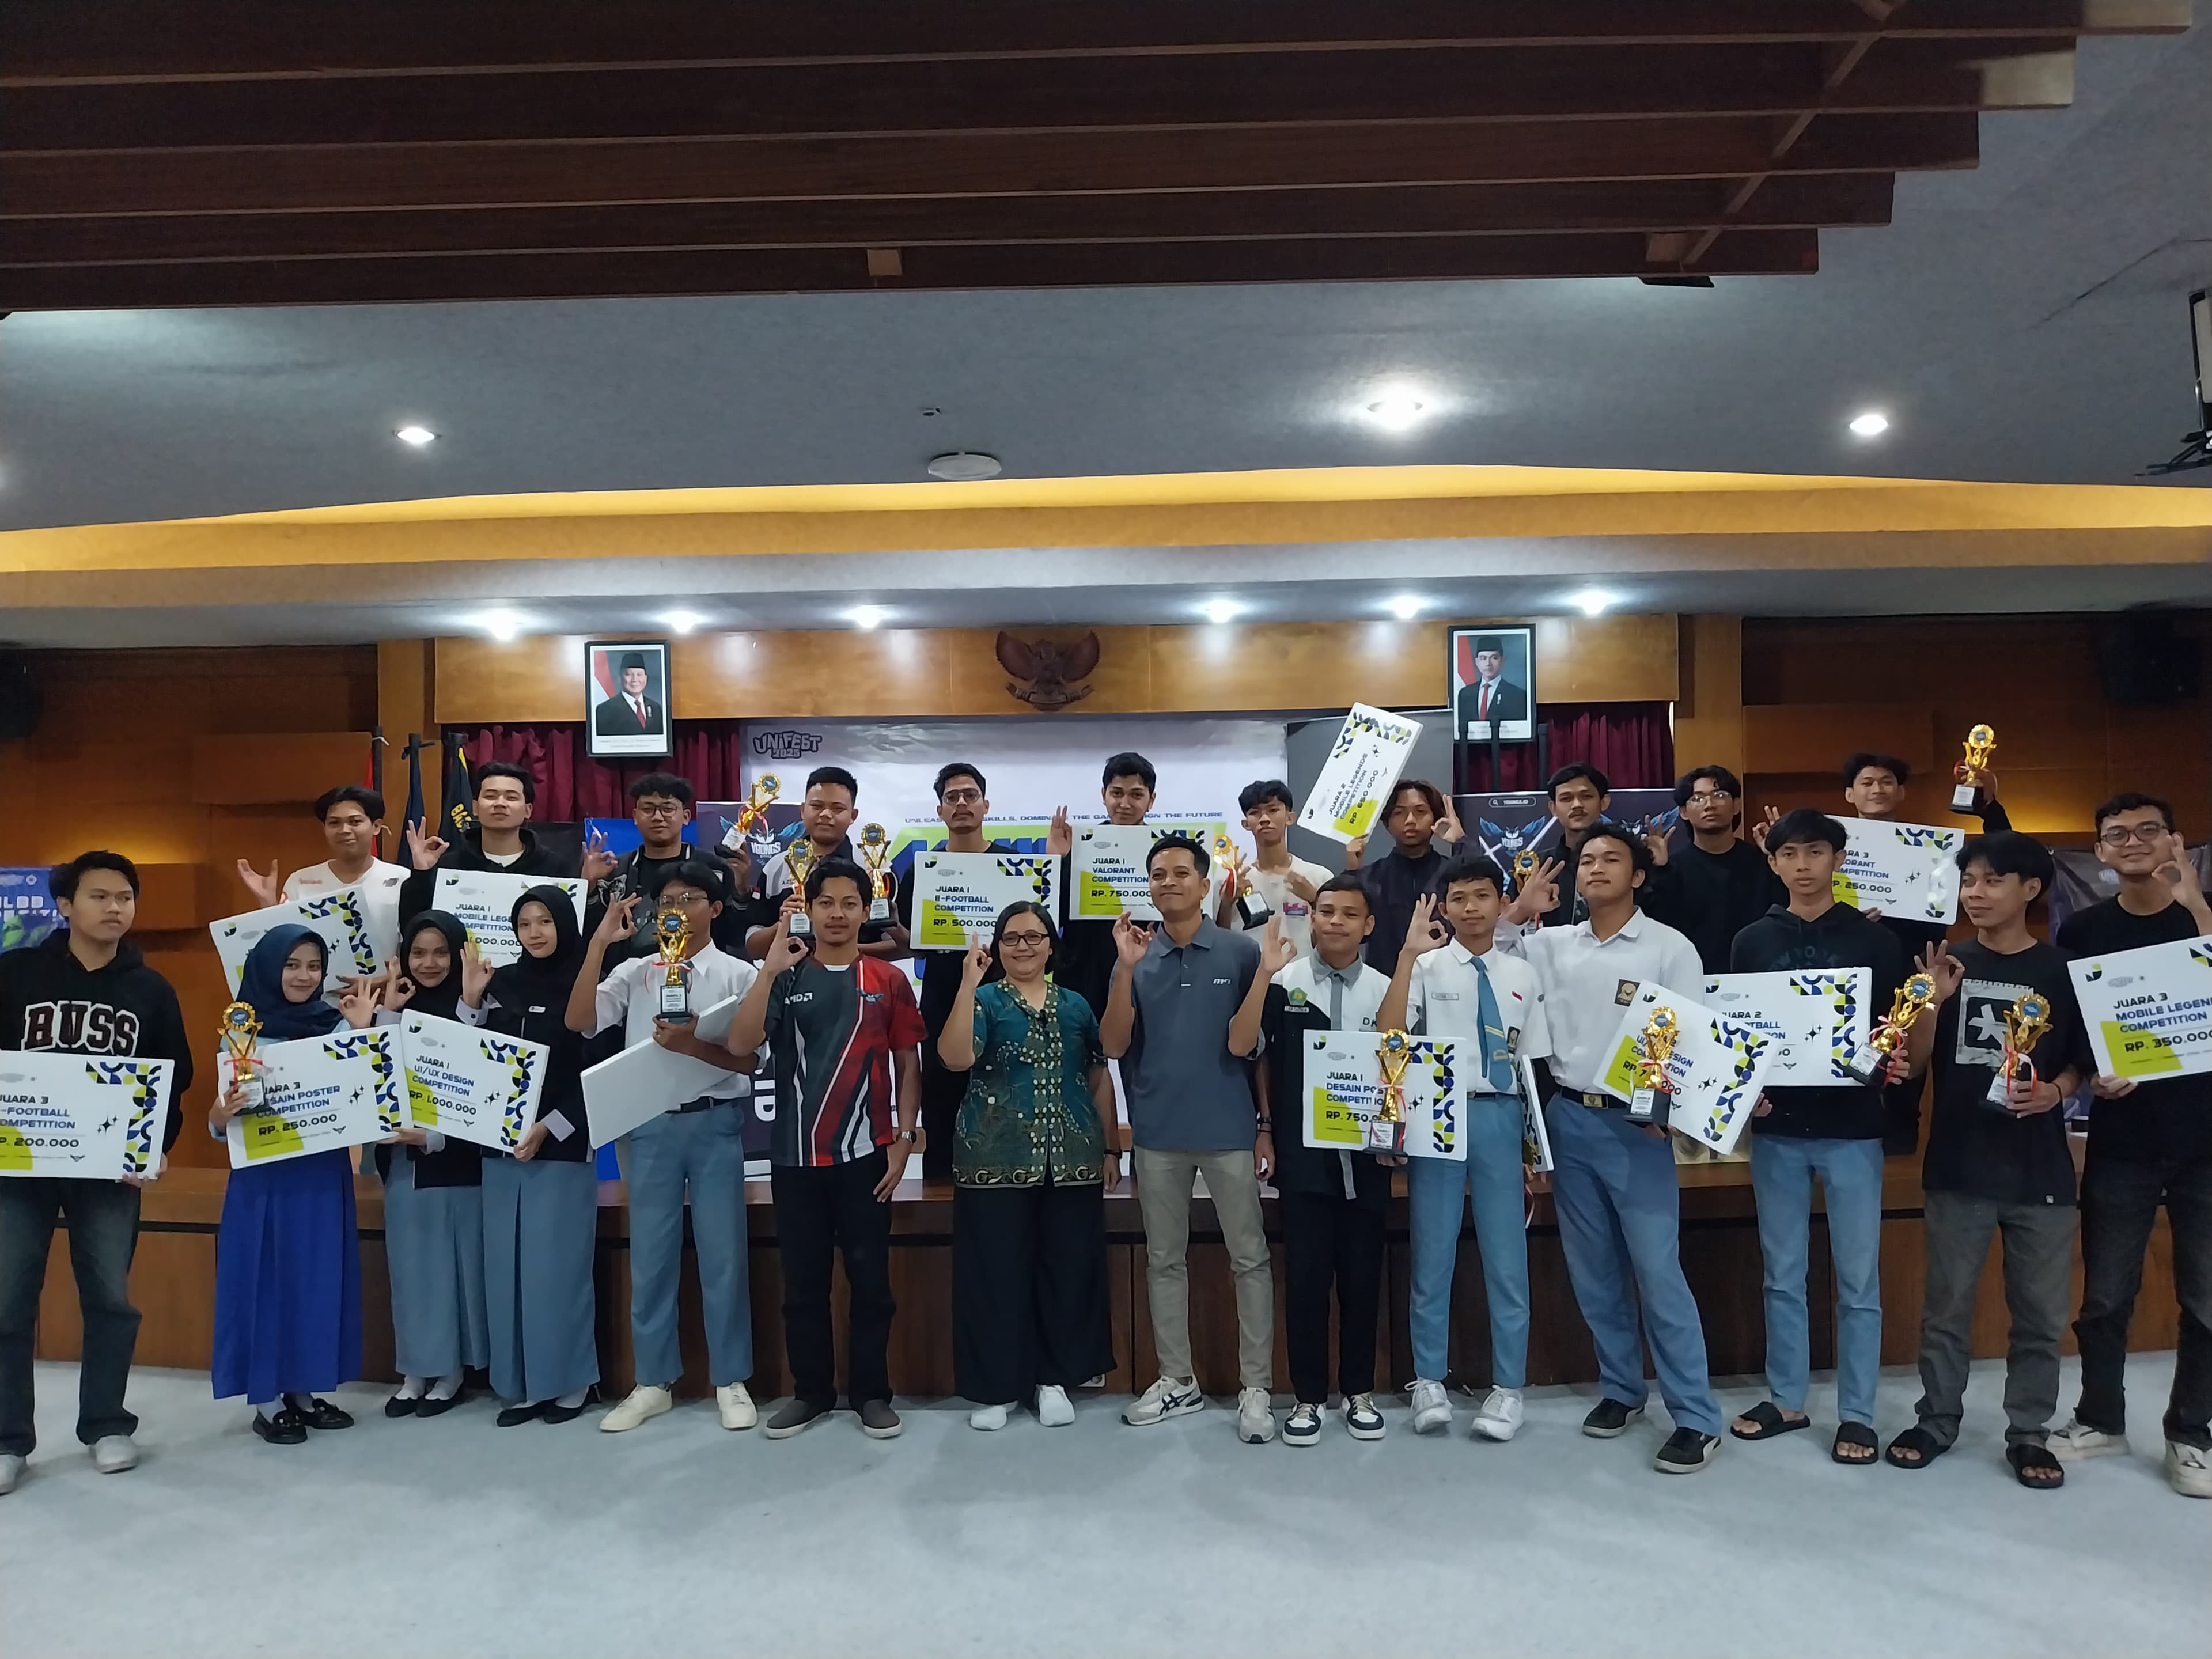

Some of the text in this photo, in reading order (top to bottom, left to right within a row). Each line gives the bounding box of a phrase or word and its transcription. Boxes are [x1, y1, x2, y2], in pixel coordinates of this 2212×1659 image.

[753, 731, 823, 754] UNIFEST
[771, 749, 801, 759] 2025
[1334, 753, 1368, 818] MOBILE LEGENDS
[1340, 770, 1368, 820] COMPETITION
[1328, 791, 1342, 815] JUARA
[1844, 859, 1876, 868] ORANT
[1840, 868, 1889, 879] MPETITION
[1844, 881, 1892, 893] 250.000
[935, 895, 990, 903] E-FOOTBALL
[455, 903, 486, 912] JUARA
[934, 904, 994, 912] COMPETITION
[454, 912, 488, 921] MOBILE
[463, 923, 514, 931] MPETITION
[2113, 993, 2168, 1009] JUARA 3
[2115, 997, 2212, 1022] MOBILE LEGEN
[2120, 1011, 2208, 1033] COMPETITION
[21, 1001, 139, 1057] BUSS
[2124, 1041, 2150, 1053] RP.
[416, 1055, 444, 1069] JUARA
[414, 1064, 475, 1086] UI/UX DESIGN
[1327, 1071, 1358, 1081] JUARA
[293, 1081, 301, 1090] 3
[412, 1075, 471, 1096] COMPETITION
[1327, 1082, 1385, 1094] DESAIN POS
[0, 1094, 49, 1104] UARA 3
[270, 1085, 340, 1105] SAIN POSTER
[1326, 1094, 1384, 1106] COMPETITIO
[0, 1106, 70, 1117] -FOOTBALL
[1326, 1110, 1343, 1120] RP.
[0, 1119, 76, 1130] OMPETITION
[258, 1113, 338, 1136] RP. 250.000
[14, 1137, 80, 1148] 200.000
